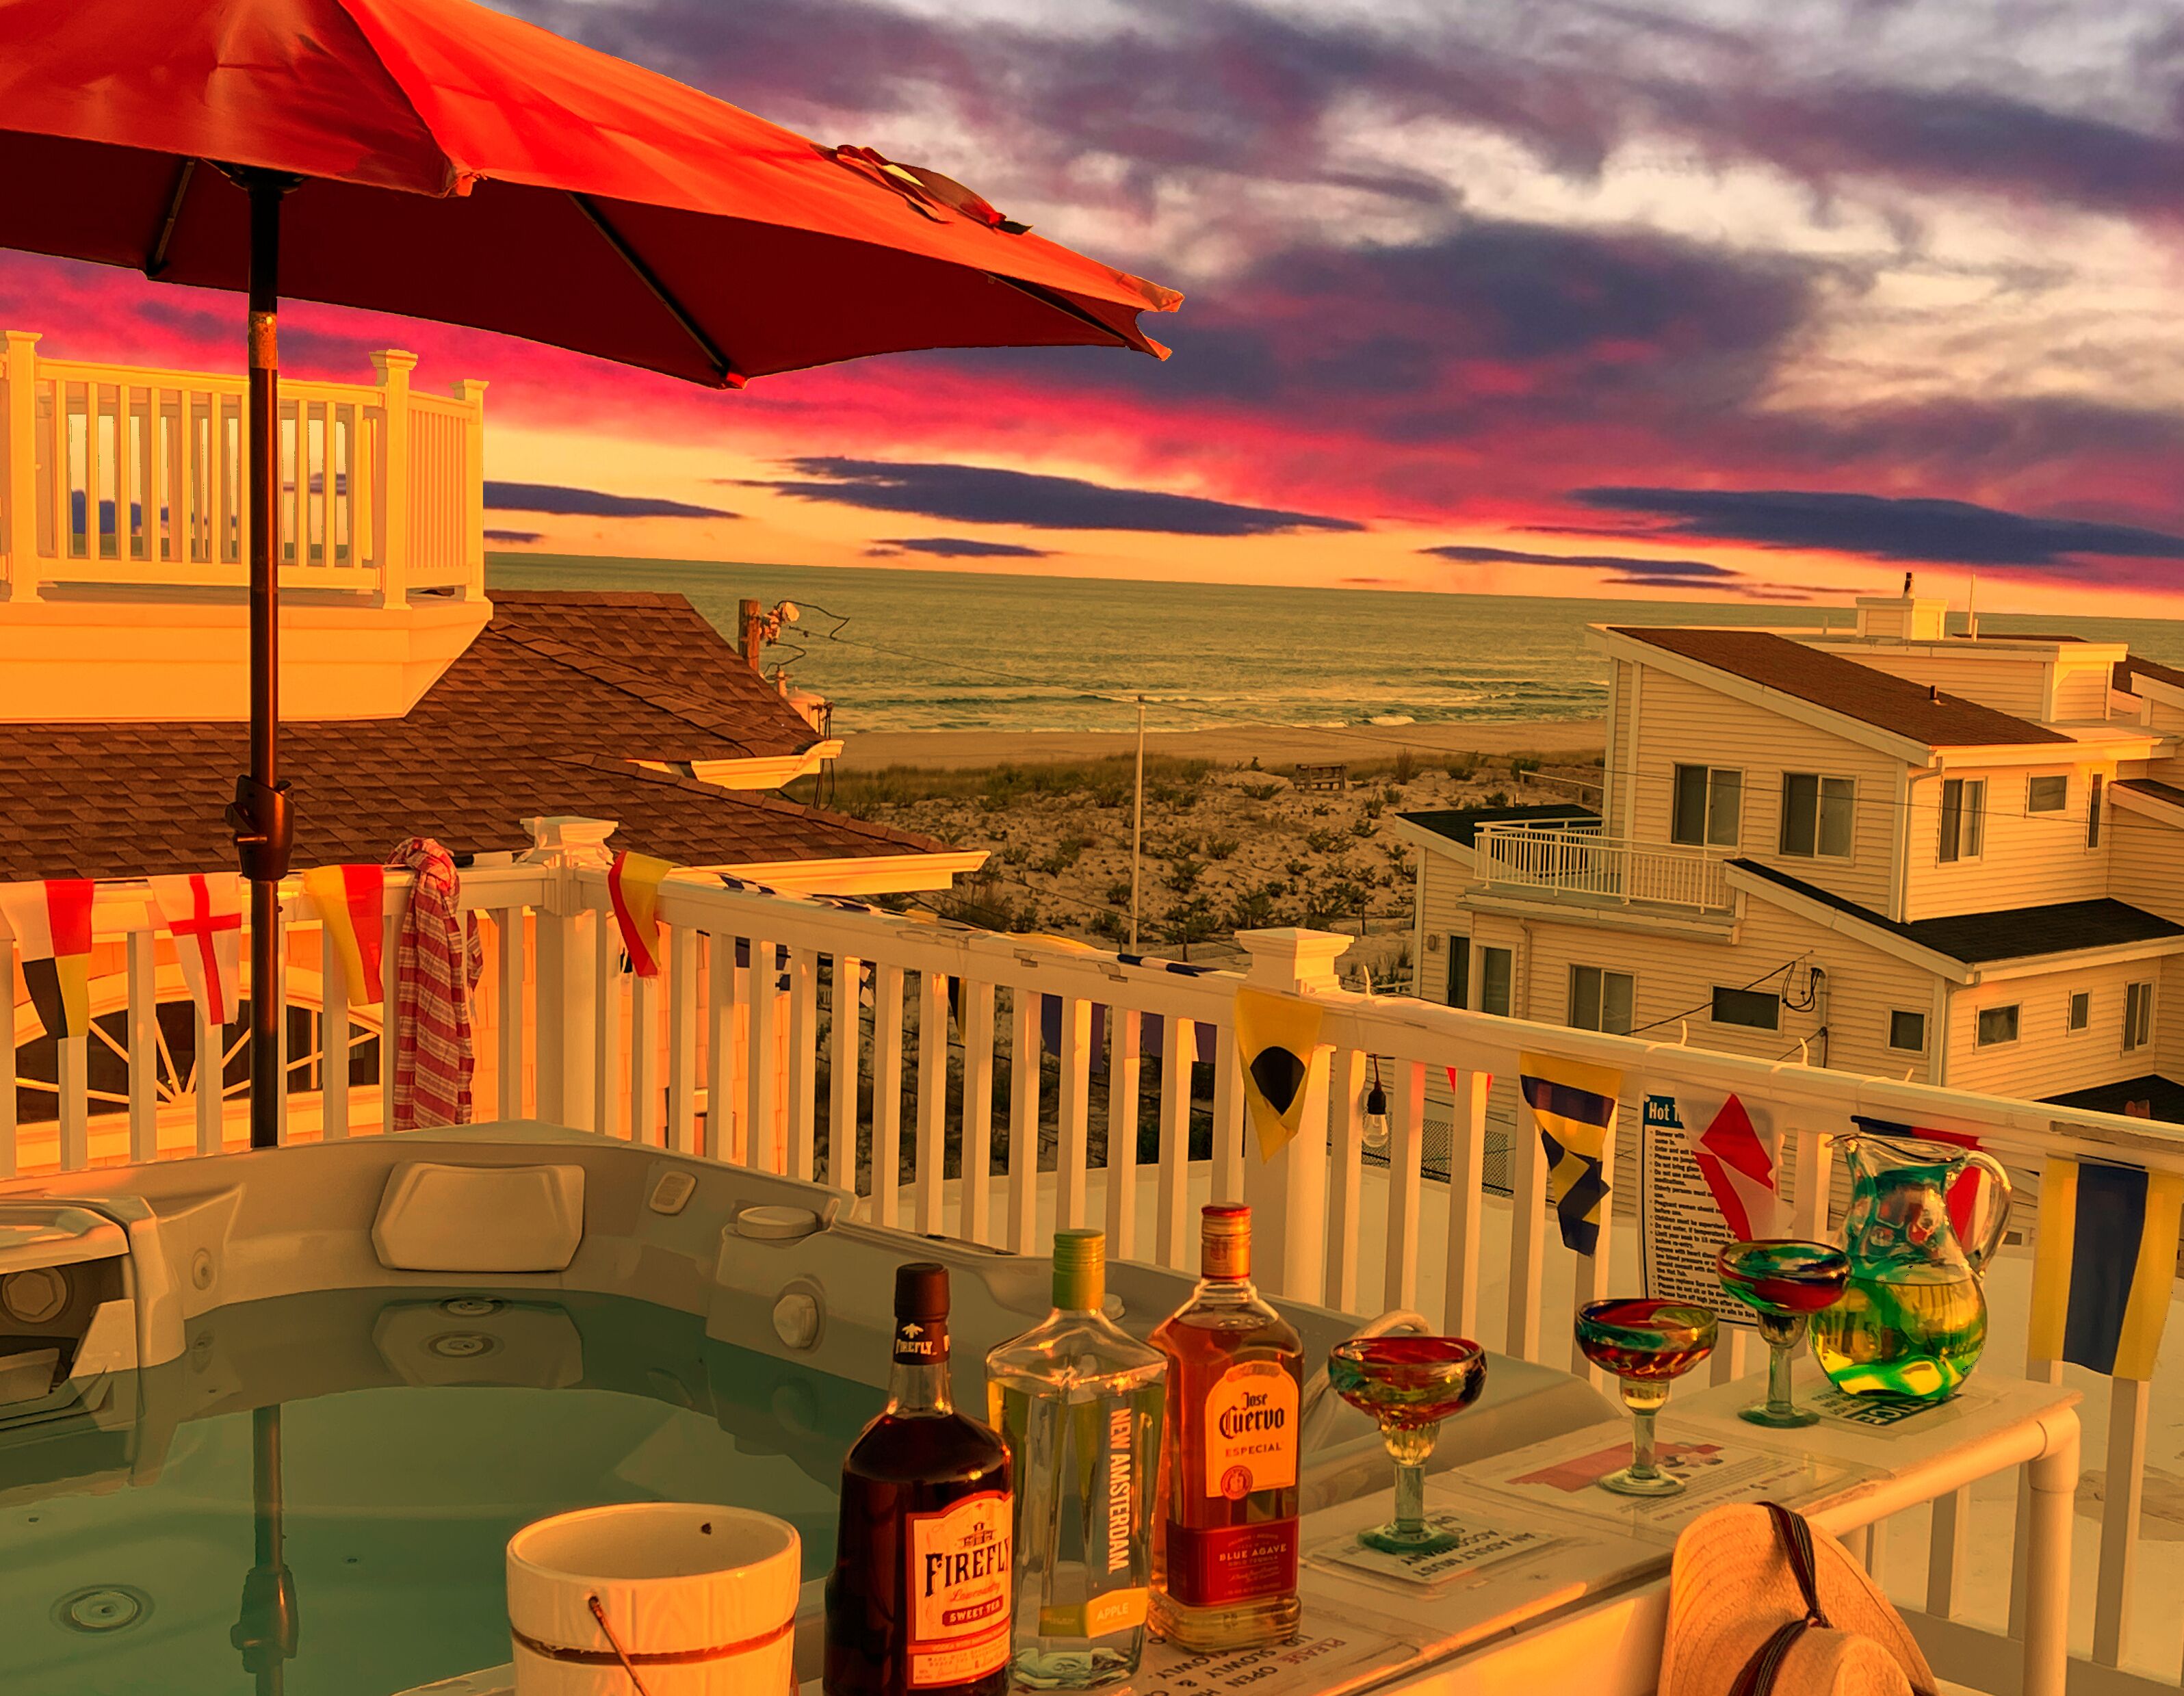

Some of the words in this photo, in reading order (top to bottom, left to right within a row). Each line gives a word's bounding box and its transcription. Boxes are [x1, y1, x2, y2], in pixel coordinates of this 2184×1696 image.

[1649, 1102, 1669, 1121] Hot
[1241, 1392, 1268, 1411] Jose
[1110, 1408, 1131, 1450] NEW
[1219, 1405, 1285, 1439] Cuervo
[1225, 1441, 1282, 1457] ESPECIAL
[1108, 1453, 1131, 1572] AMSTERDAM
[1219, 1550, 1248, 1562] BLUE
[1251, 1543, 1287, 1557] AGAVE
[925, 1537, 1011, 1598] FIREFLY
[949, 1606, 984, 1623] SWEET
[986, 1600, 1001, 1616] TEA
[1096, 1602, 1129, 1622] APPLE
[1277, 1638, 1346, 1666] PLEASE
[1205, 1649, 1277, 1680] SLOWLY
[1225, 1665, 1279, 1688] OPEN
